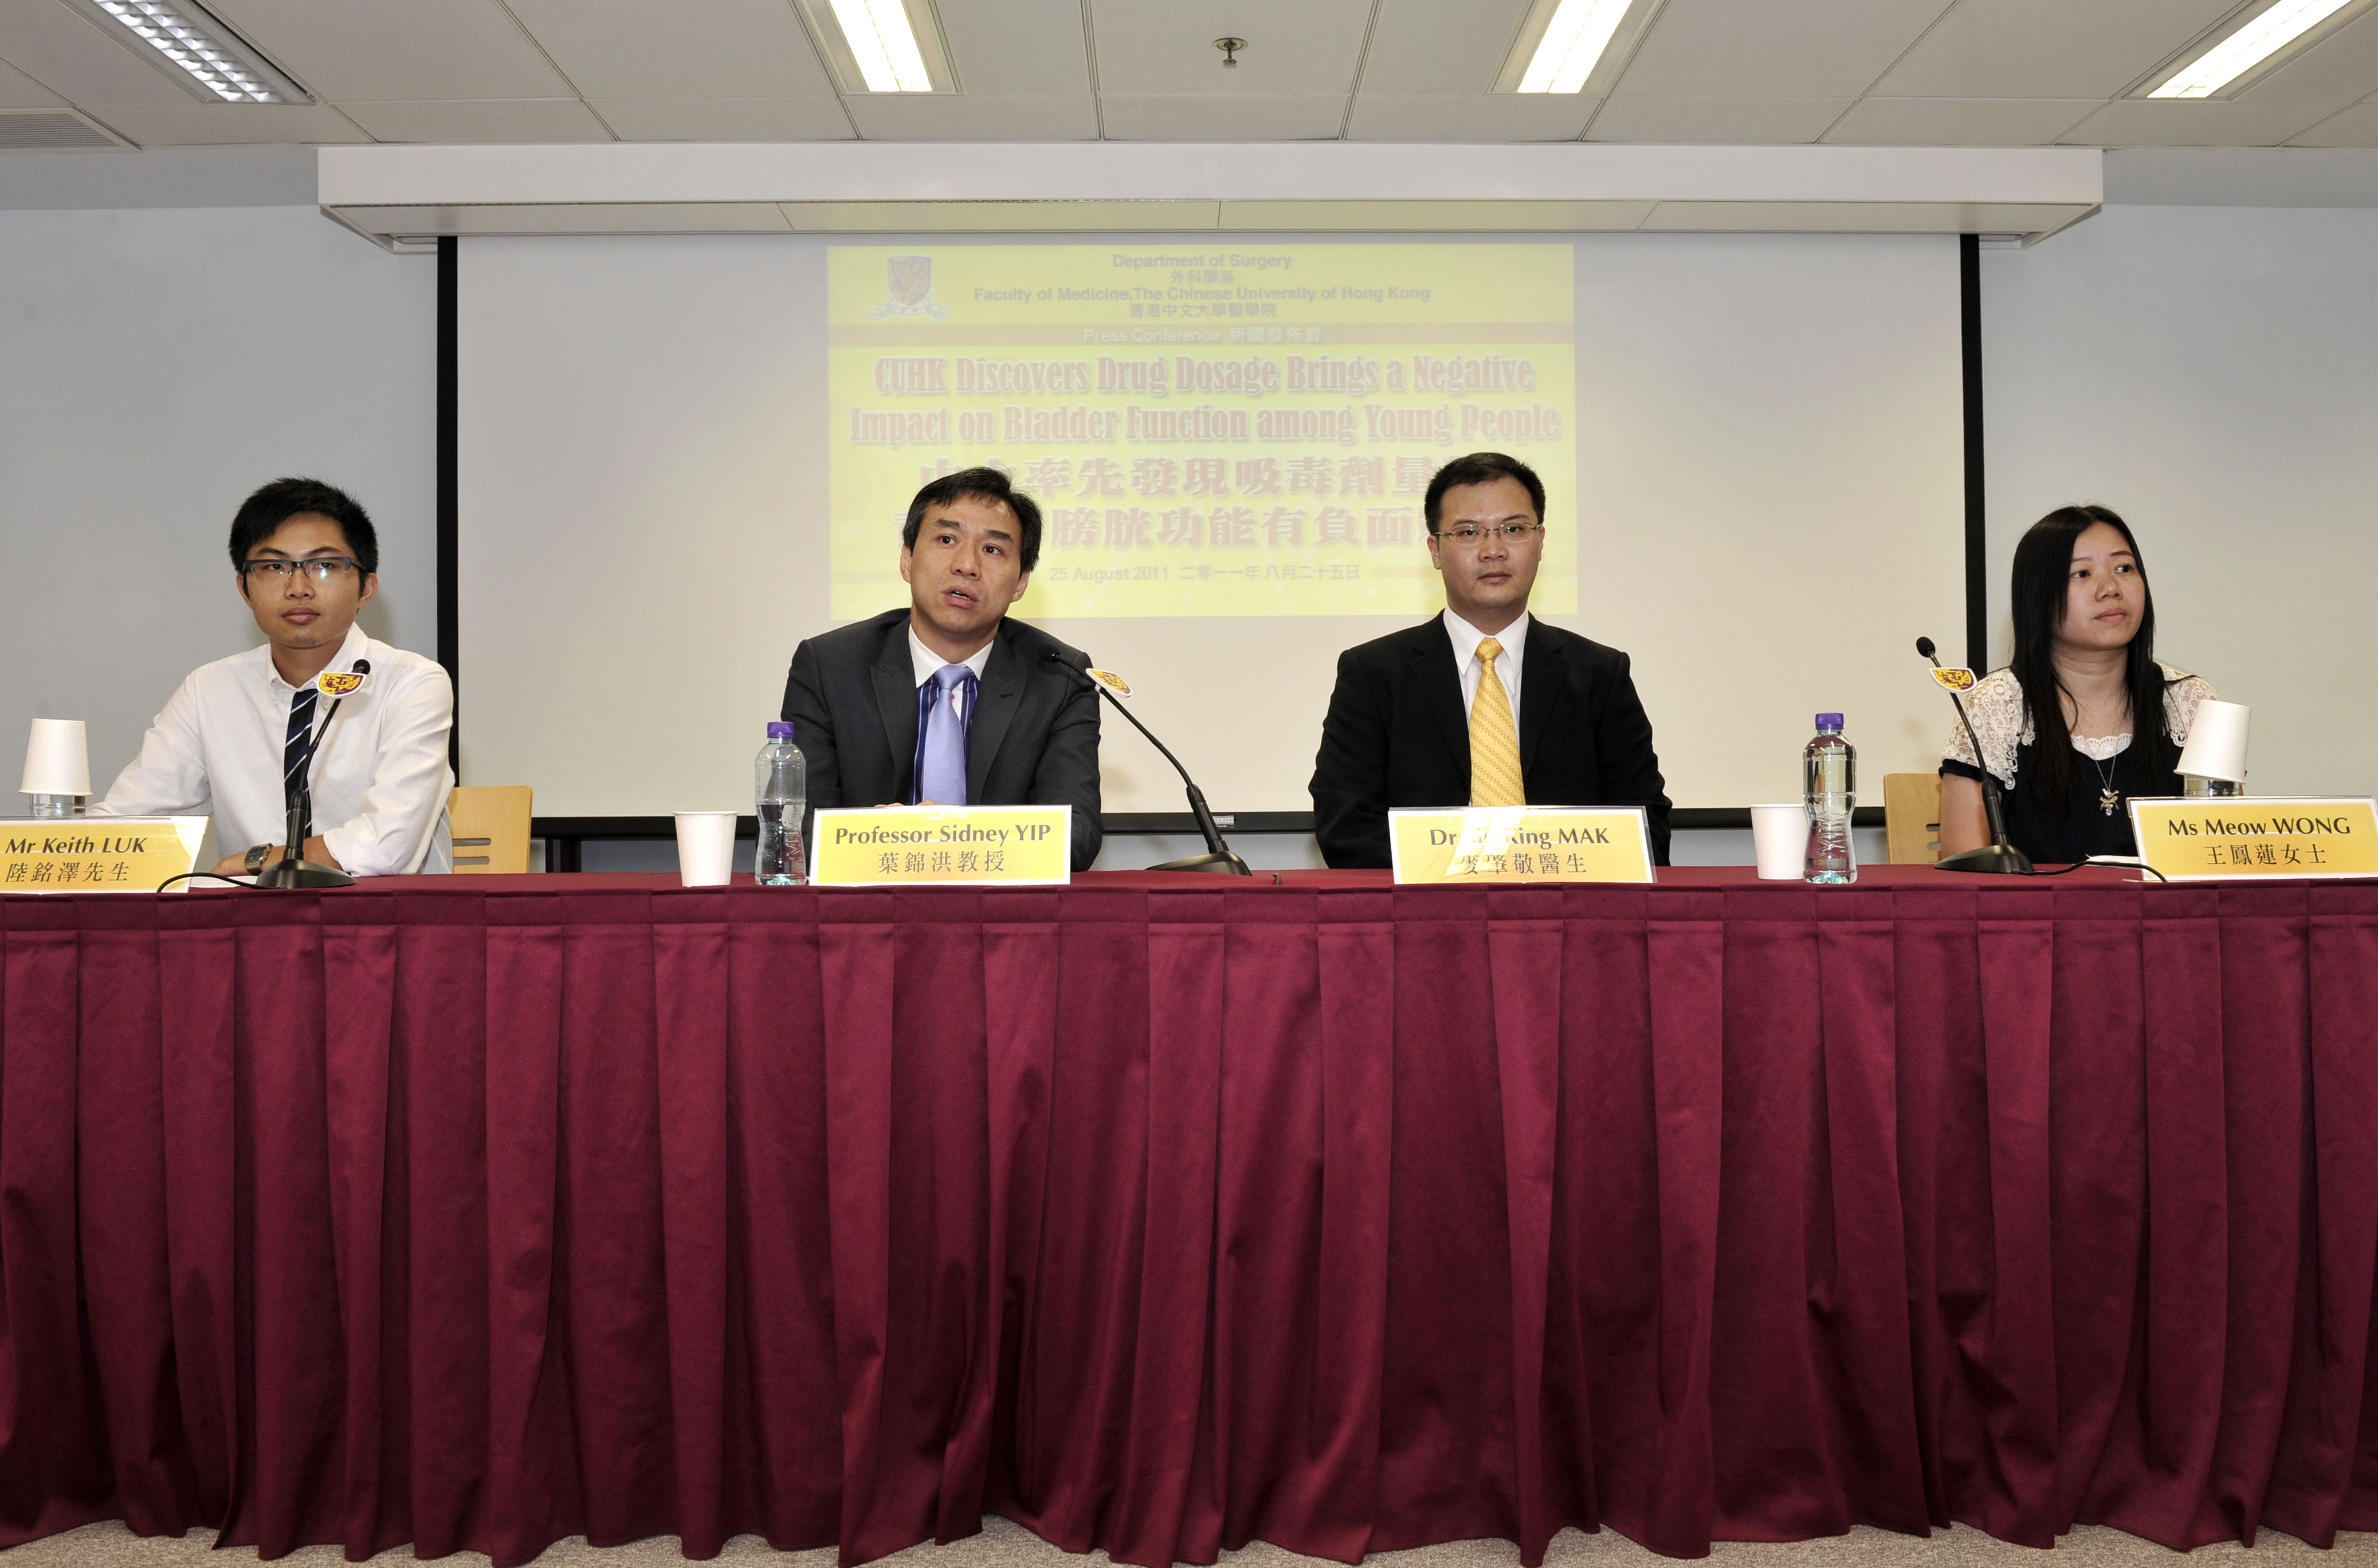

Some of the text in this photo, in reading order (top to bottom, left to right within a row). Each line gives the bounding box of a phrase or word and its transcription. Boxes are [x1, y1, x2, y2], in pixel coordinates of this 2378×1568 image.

[1113, 254, 1291, 270] Department of Surgery
[1170, 270, 1235, 285] 外科學系
[974, 288, 1032, 304] Faculty
[1037, 288, 1053, 301] of
[1167, 287, 1231, 300] Chinese
[1237, 287, 1316, 302] University
[1321, 287, 1337, 300] of
[1341, 287, 1384, 302] Hong
[1388, 286, 1431, 302] Kong
[1129, 303, 1277, 317] 香港中文大學醫學院
[1083, 329, 1128, 342] Press
[1132, 328, 1220, 342] Conference
[874, 355, 1535, 395] CUHK Discovers Drug Dosage Brings a Negative
[849, 403, 1561, 447] Impact on Bladder Function among Young People
[920, 456, 1458, 497] 率先發現吸毒劑量
[1049, 567, 1068, 581] 25
[1073, 566, 1130, 584] August
[1133, 567, 1169, 580] 2011
[835, 824, 1051, 846] Professor Sidney YIP
[2168, 817, 2350, 836] Ms Meow WONG
[5, 836, 148, 854] Mr Keith LUK
[1430, 829, 1457, 845] Dr
[1558, 828, 1610, 844] MAK
[878, 850, 1004, 874] 葉錦洪教授
[2205, 844, 2327, 866] 王鳳蓮女士
[5, 862, 130, 883] 陸銘澤先生
